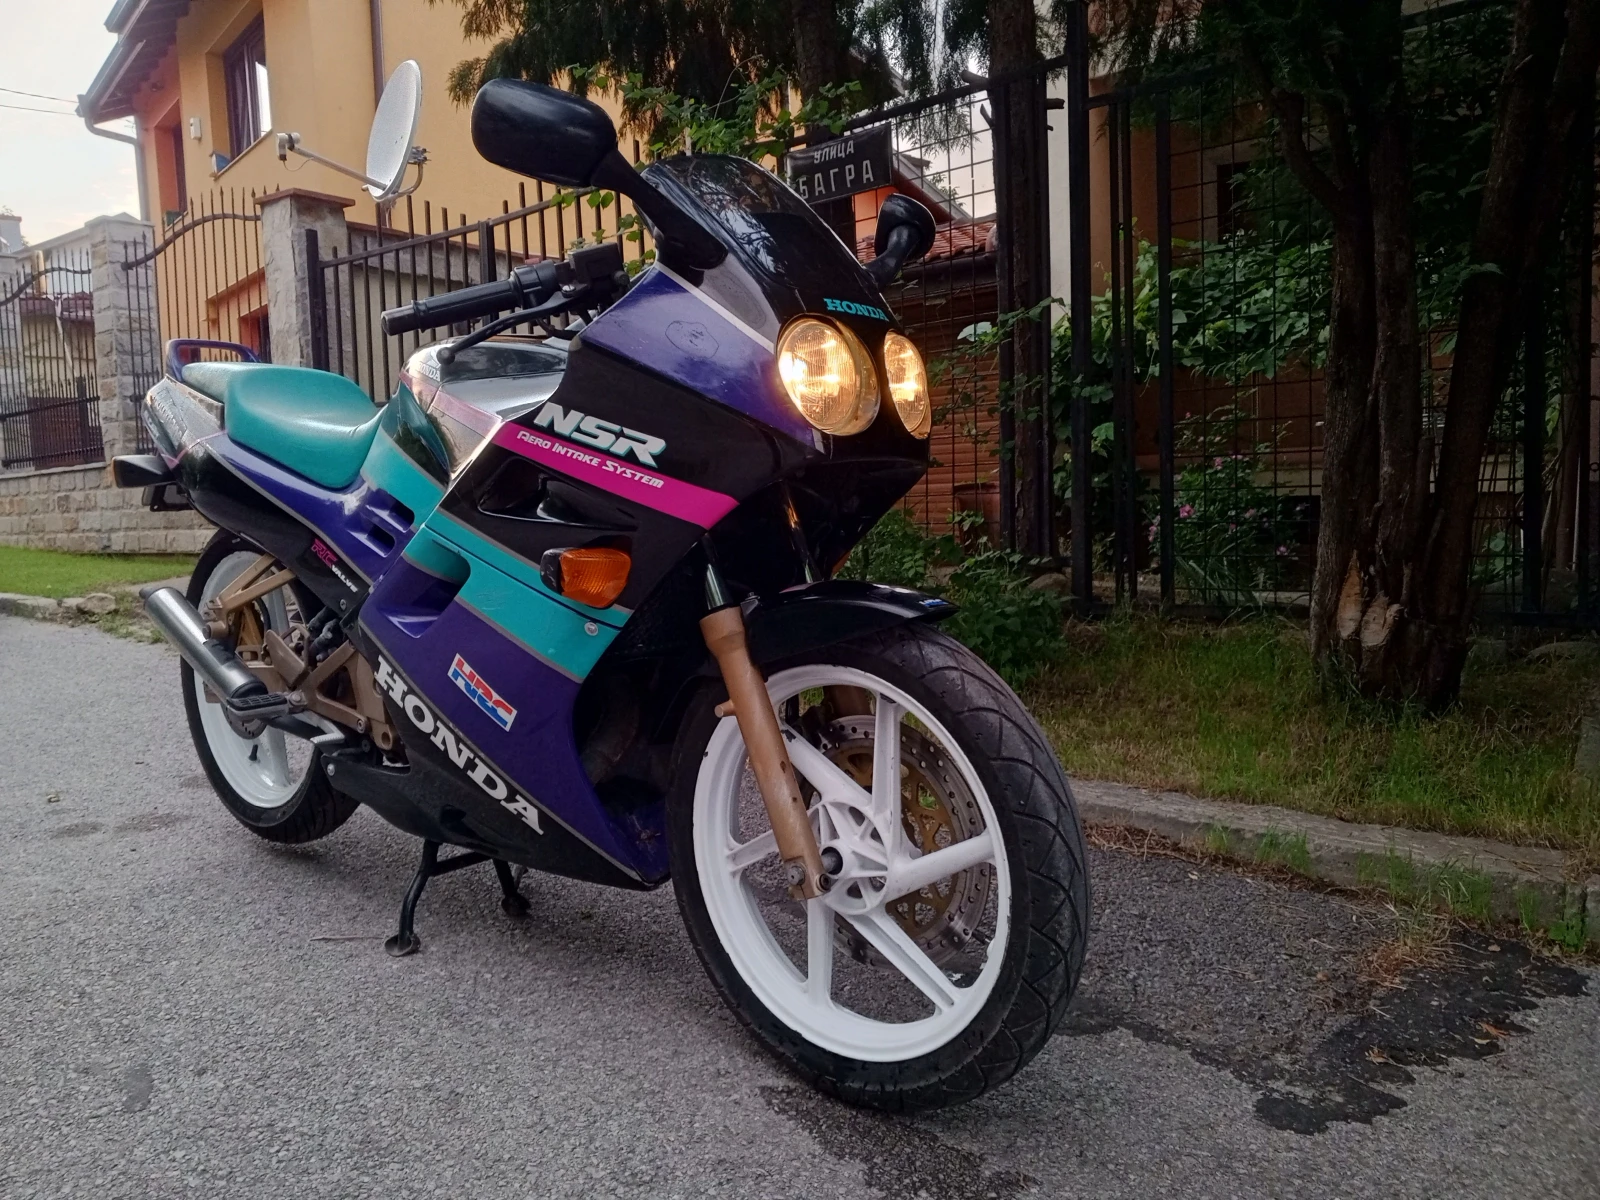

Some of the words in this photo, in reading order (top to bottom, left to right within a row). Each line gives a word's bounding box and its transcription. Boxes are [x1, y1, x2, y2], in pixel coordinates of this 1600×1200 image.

[814, 140, 855, 164] УЛИЦА
[799, 160, 874, 200] БАГРА
[823, 298, 890, 322] HONDA
[533, 401, 667, 468] NSR
[516, 430, 552, 450] AERO
[551, 442, 602, 467] INTAKE
[602, 460, 665, 489] SYSTEM
[331, 564, 359, 593] VALVE
[450, 656, 514, 729] HRC
[373, 654, 545, 836] HONDA
